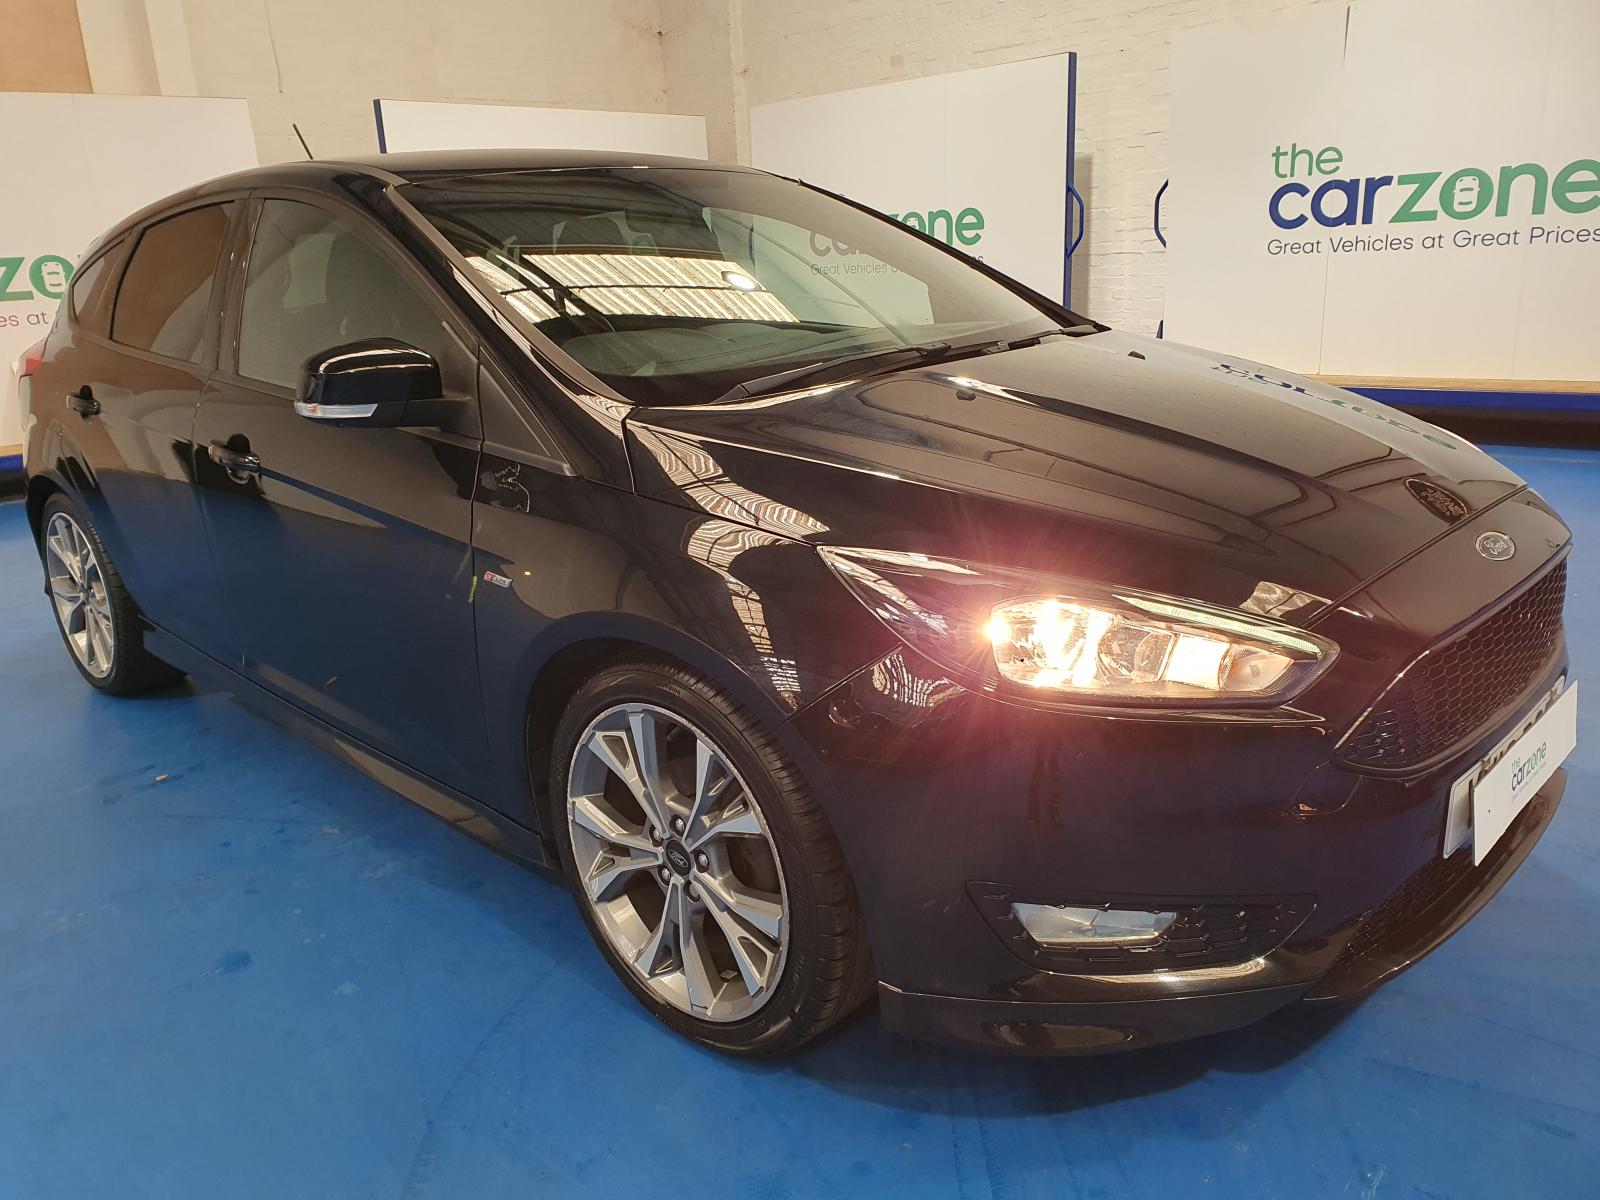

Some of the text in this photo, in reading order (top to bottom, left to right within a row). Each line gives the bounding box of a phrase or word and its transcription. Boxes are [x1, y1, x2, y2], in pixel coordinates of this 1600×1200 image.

[1272, 143, 1344, 178] the
[1268, 159, 1600, 230] carzone
[1267, 226, 1600, 255] Great Vehicles at Great Prices
[811, 264, 841, 275] Great
[843, 261, 888, 274] Vehicles
[26, 311, 49, 326] at
[1483, 536, 1508, 556] Ford
[1511, 741, 1547, 791] carzone
